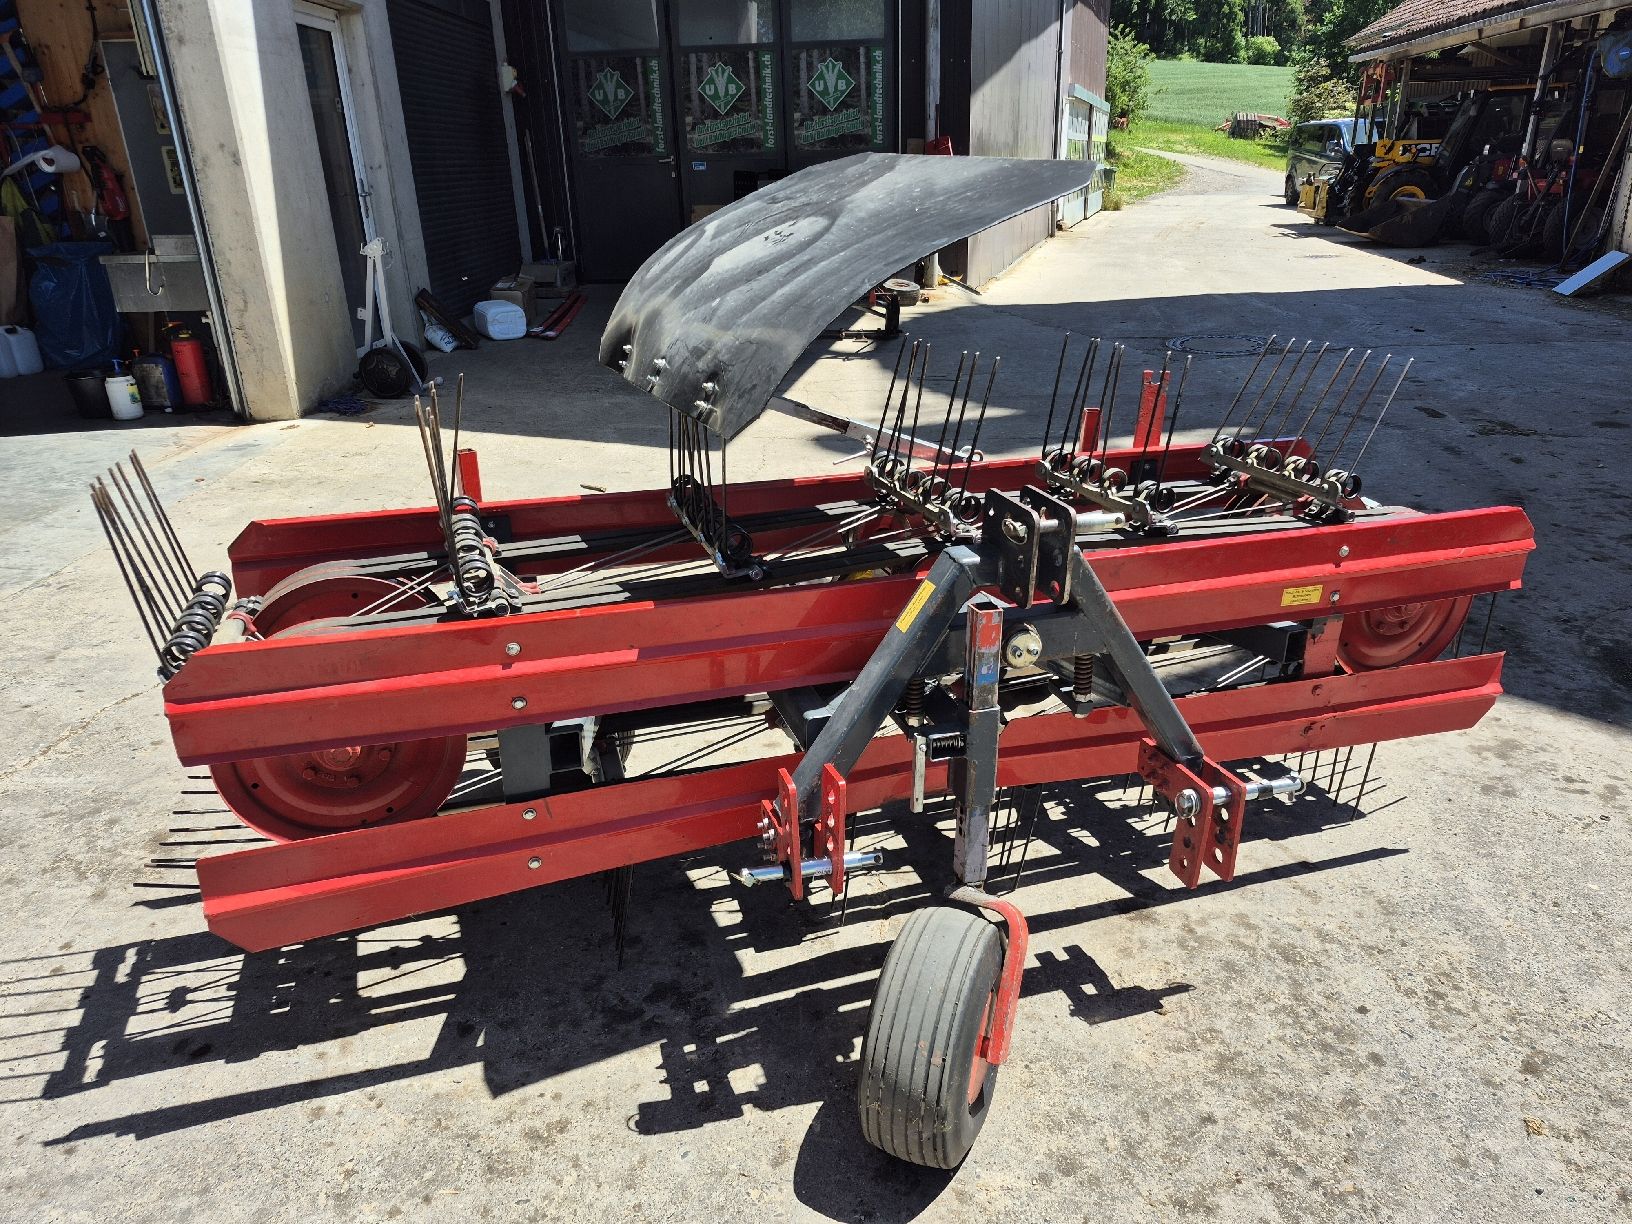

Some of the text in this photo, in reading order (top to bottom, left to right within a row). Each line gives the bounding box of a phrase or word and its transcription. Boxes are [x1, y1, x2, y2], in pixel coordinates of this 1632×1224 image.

[649, 60, 665, 152] forst-landtechnik.ch
[761, 54, 775, 148] forst-landtechnik.ch
[873, 50, 884, 144] forst-landtechnik.ch
